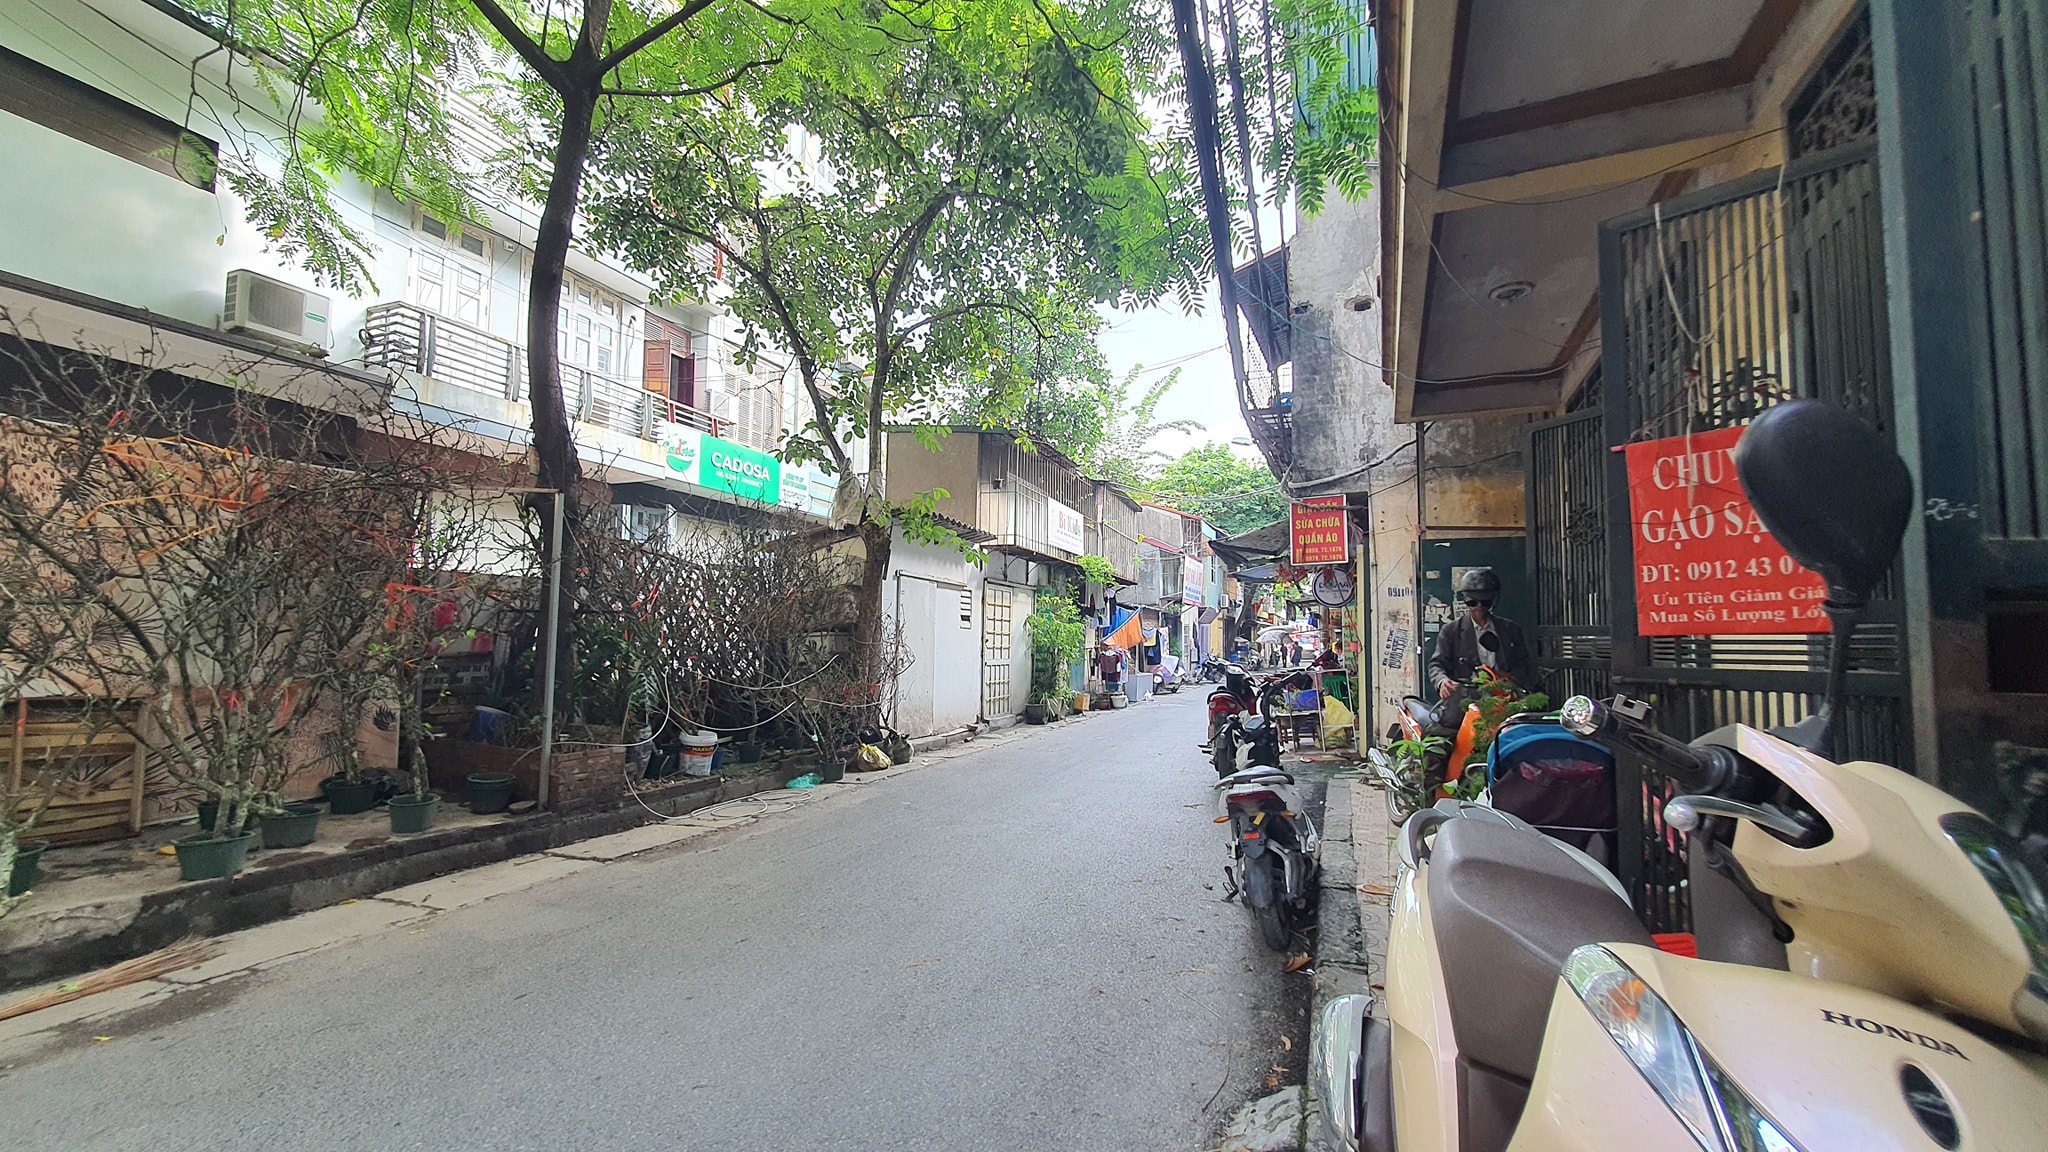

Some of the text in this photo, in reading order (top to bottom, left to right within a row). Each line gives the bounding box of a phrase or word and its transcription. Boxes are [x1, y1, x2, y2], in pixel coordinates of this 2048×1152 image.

[711, 452, 770, 481] CADOSA
[1642, 501, 1769, 550] GẠO SẠ
[1641, 564, 1680, 583] ĐT:
[1687, 559, 1738, 580] 0912
[1745, 557, 1772, 577] 43
[1653, 585, 1826, 606] Ưu Tiên Giảm Giá
[1649, 611, 1688, 623] Mua
[1694, 606, 1715, 621] Số
[1721, 607, 1786, 623] Lượng
[1819, 1008, 1971, 1061] HONDA
